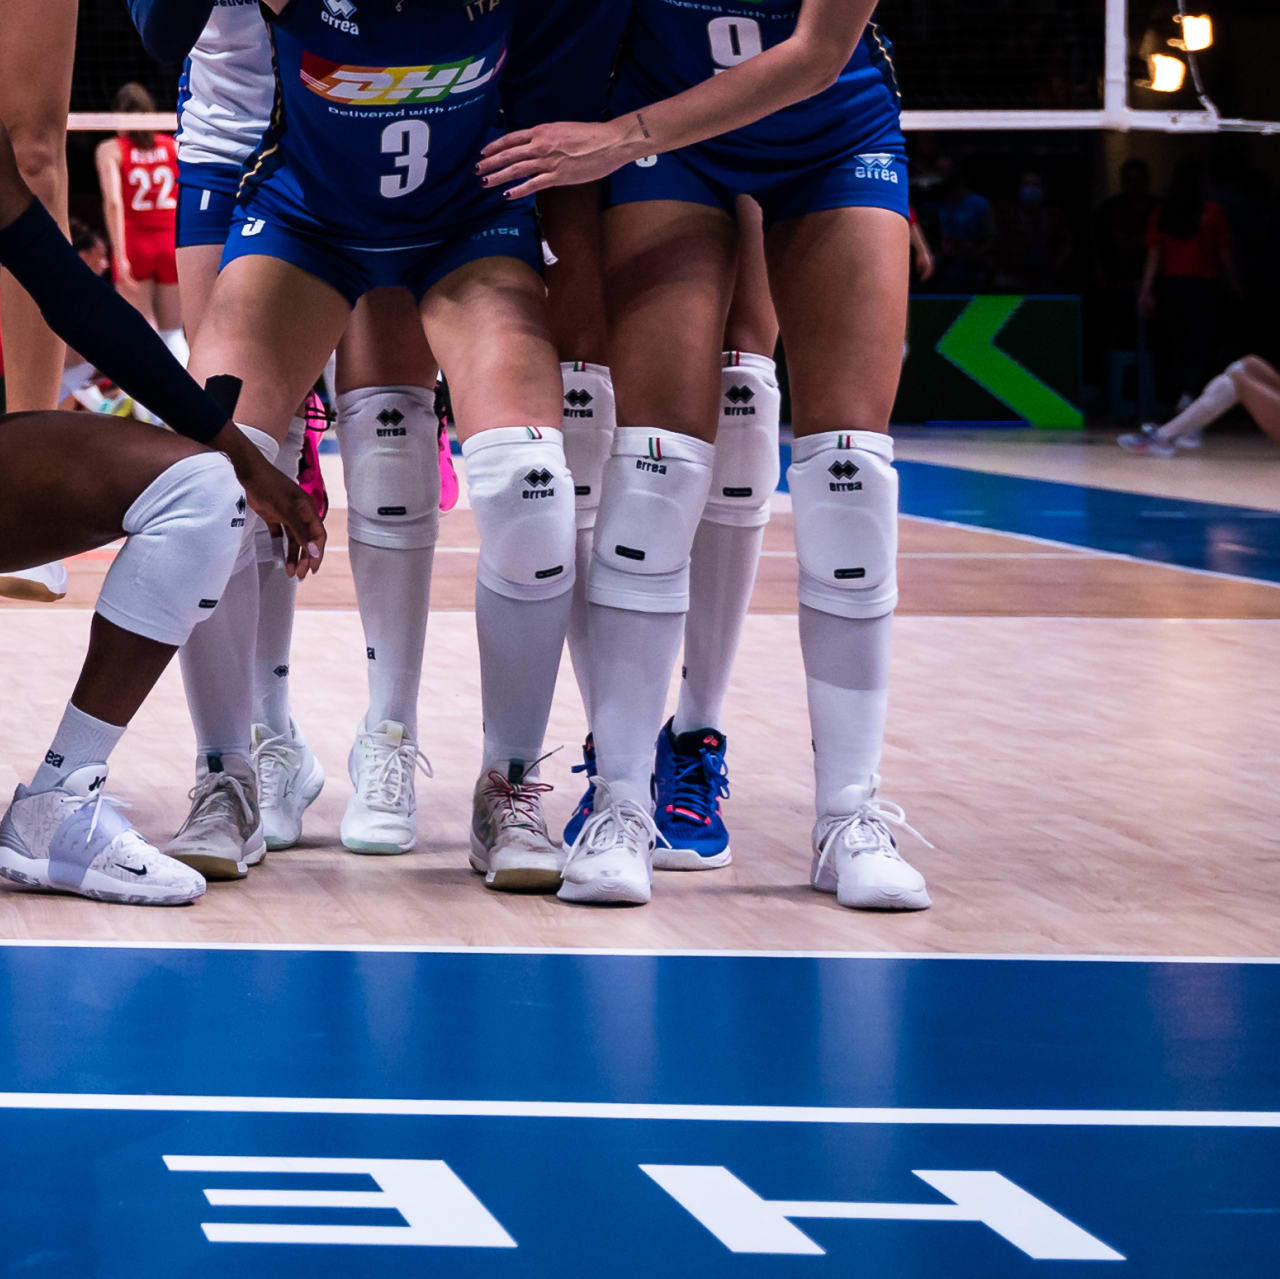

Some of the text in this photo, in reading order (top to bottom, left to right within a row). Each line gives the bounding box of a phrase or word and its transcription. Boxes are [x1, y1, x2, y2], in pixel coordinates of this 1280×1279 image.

[324, 57, 496, 99] DHL
[329, 105, 405, 119] Delivered
[380, 119, 430, 199] 3
[128, 165, 177, 211] 22
